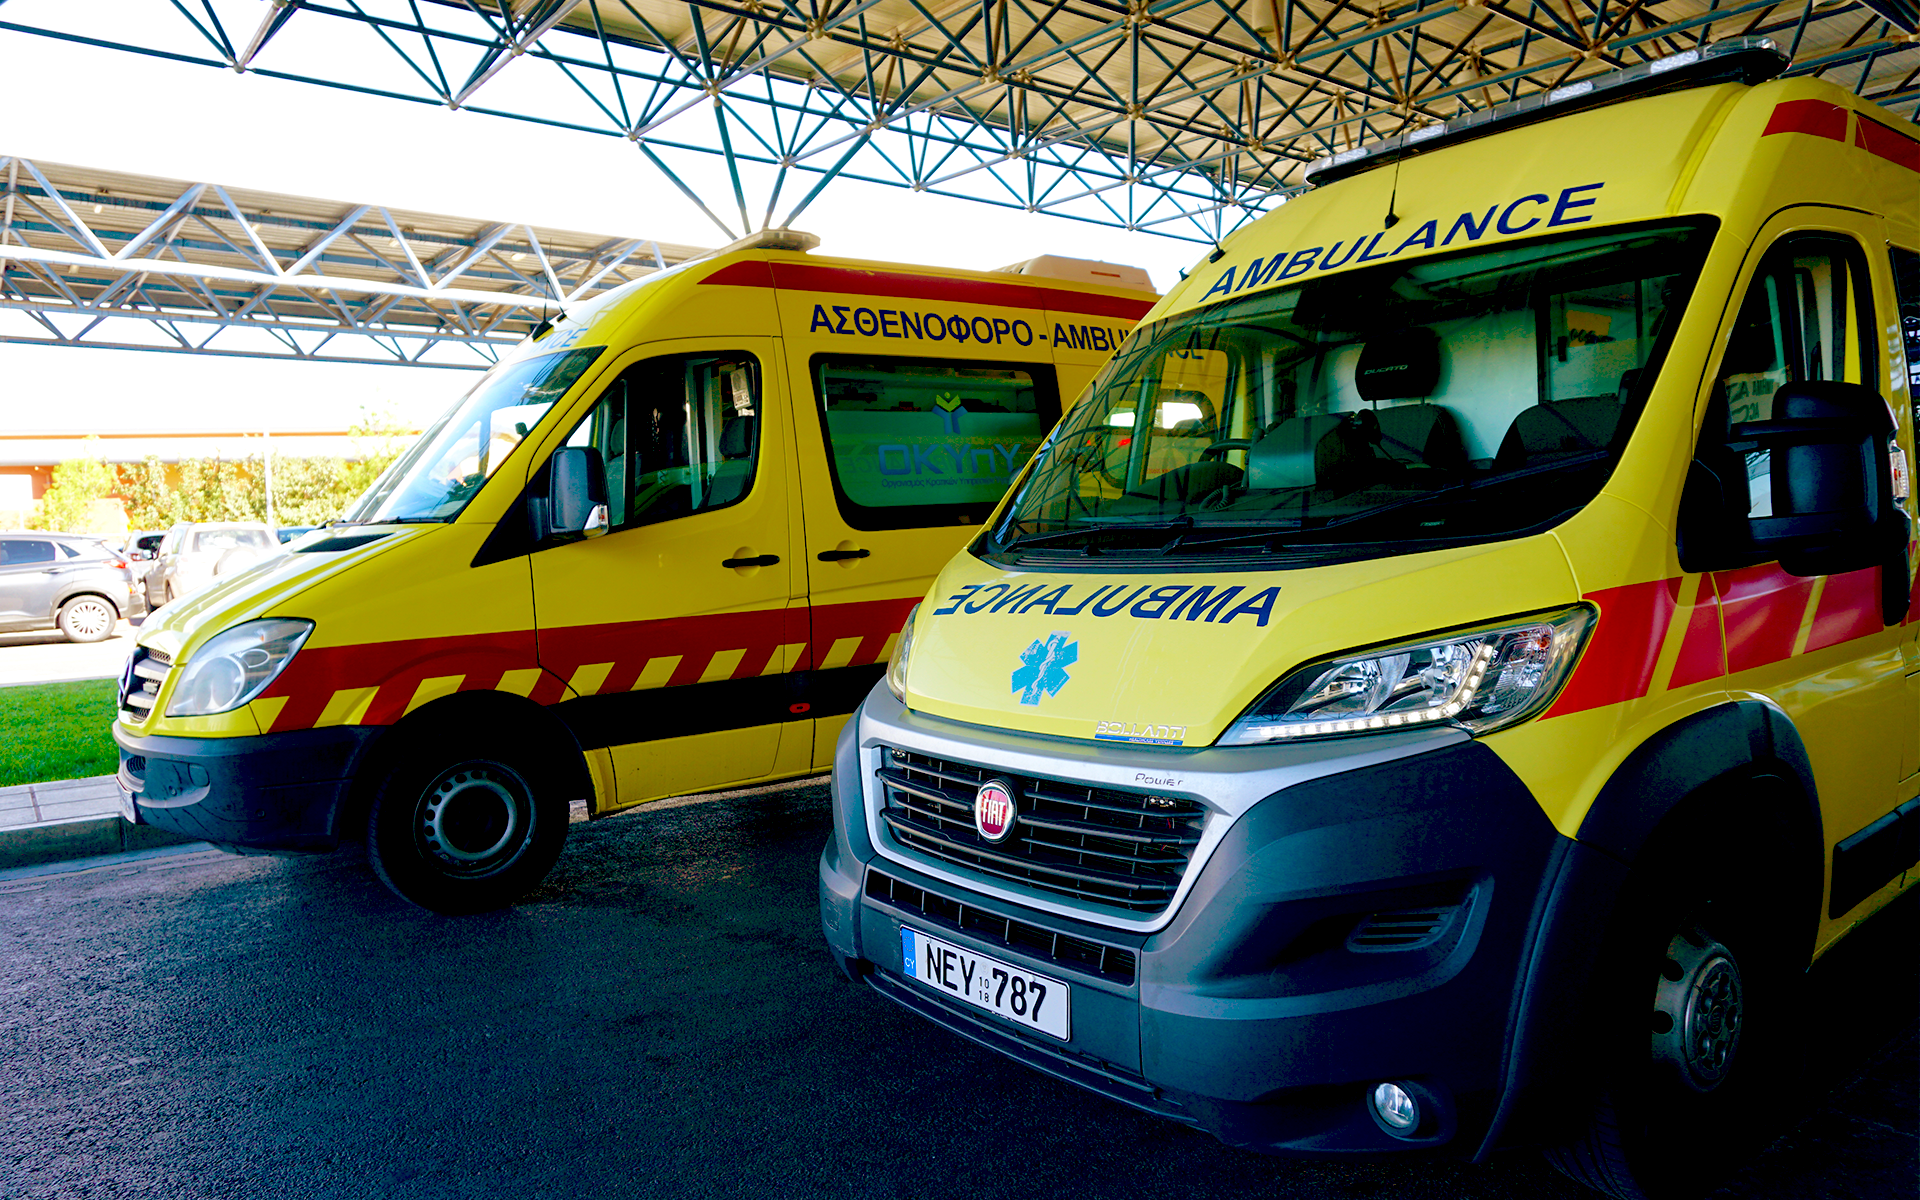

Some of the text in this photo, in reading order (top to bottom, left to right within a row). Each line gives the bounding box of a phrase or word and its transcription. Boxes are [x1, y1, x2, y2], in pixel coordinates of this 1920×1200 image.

[1199, 182, 1604, 302] AMBULANCE
[810, 304, 1033, 347] ΑΣΘΕΝΟΦΟΡΟ
[1095, 721, 1187, 739] BOLLANTI
[983, 798, 1005, 826] FIAT
[905, 957, 915, 969] CY
[926, 943, 1047, 1022] NEY 787
[979, 977, 989, 989] 10
[979, 990, 989, 1003] 18
